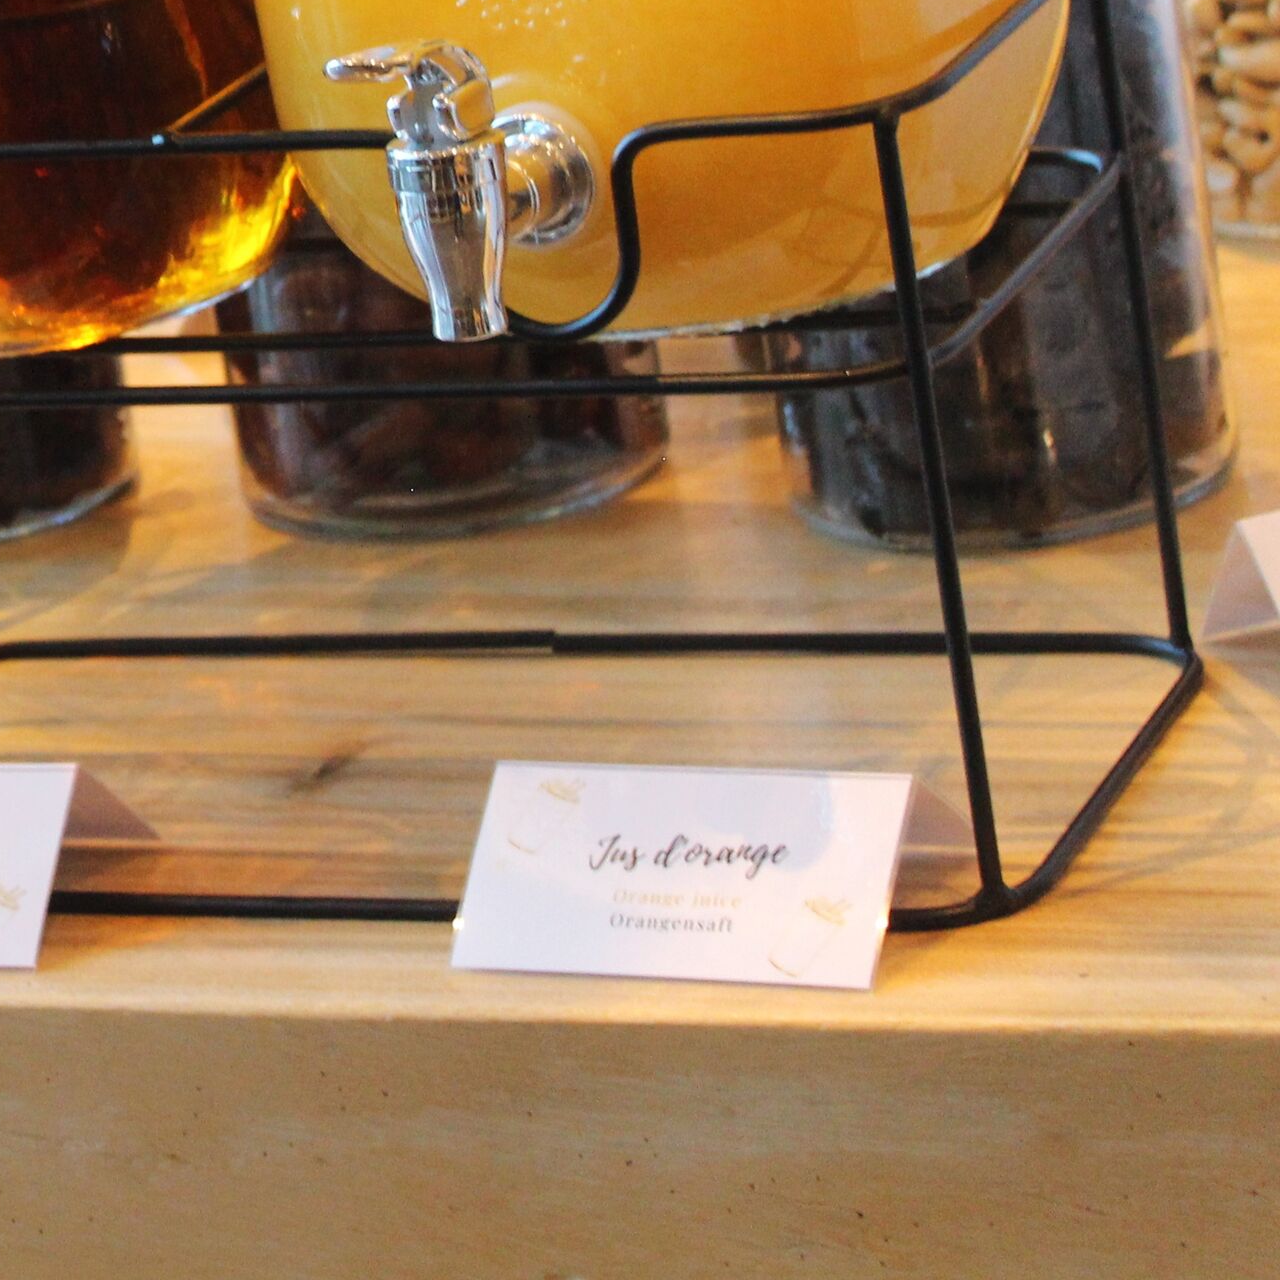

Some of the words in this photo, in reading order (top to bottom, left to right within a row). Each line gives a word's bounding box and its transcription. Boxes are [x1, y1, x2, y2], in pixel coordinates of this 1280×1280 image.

[588, 833, 642, 872] Jus
[653, 832, 789, 880] d'orange
[608, 912, 734, 934] Orangensaft
